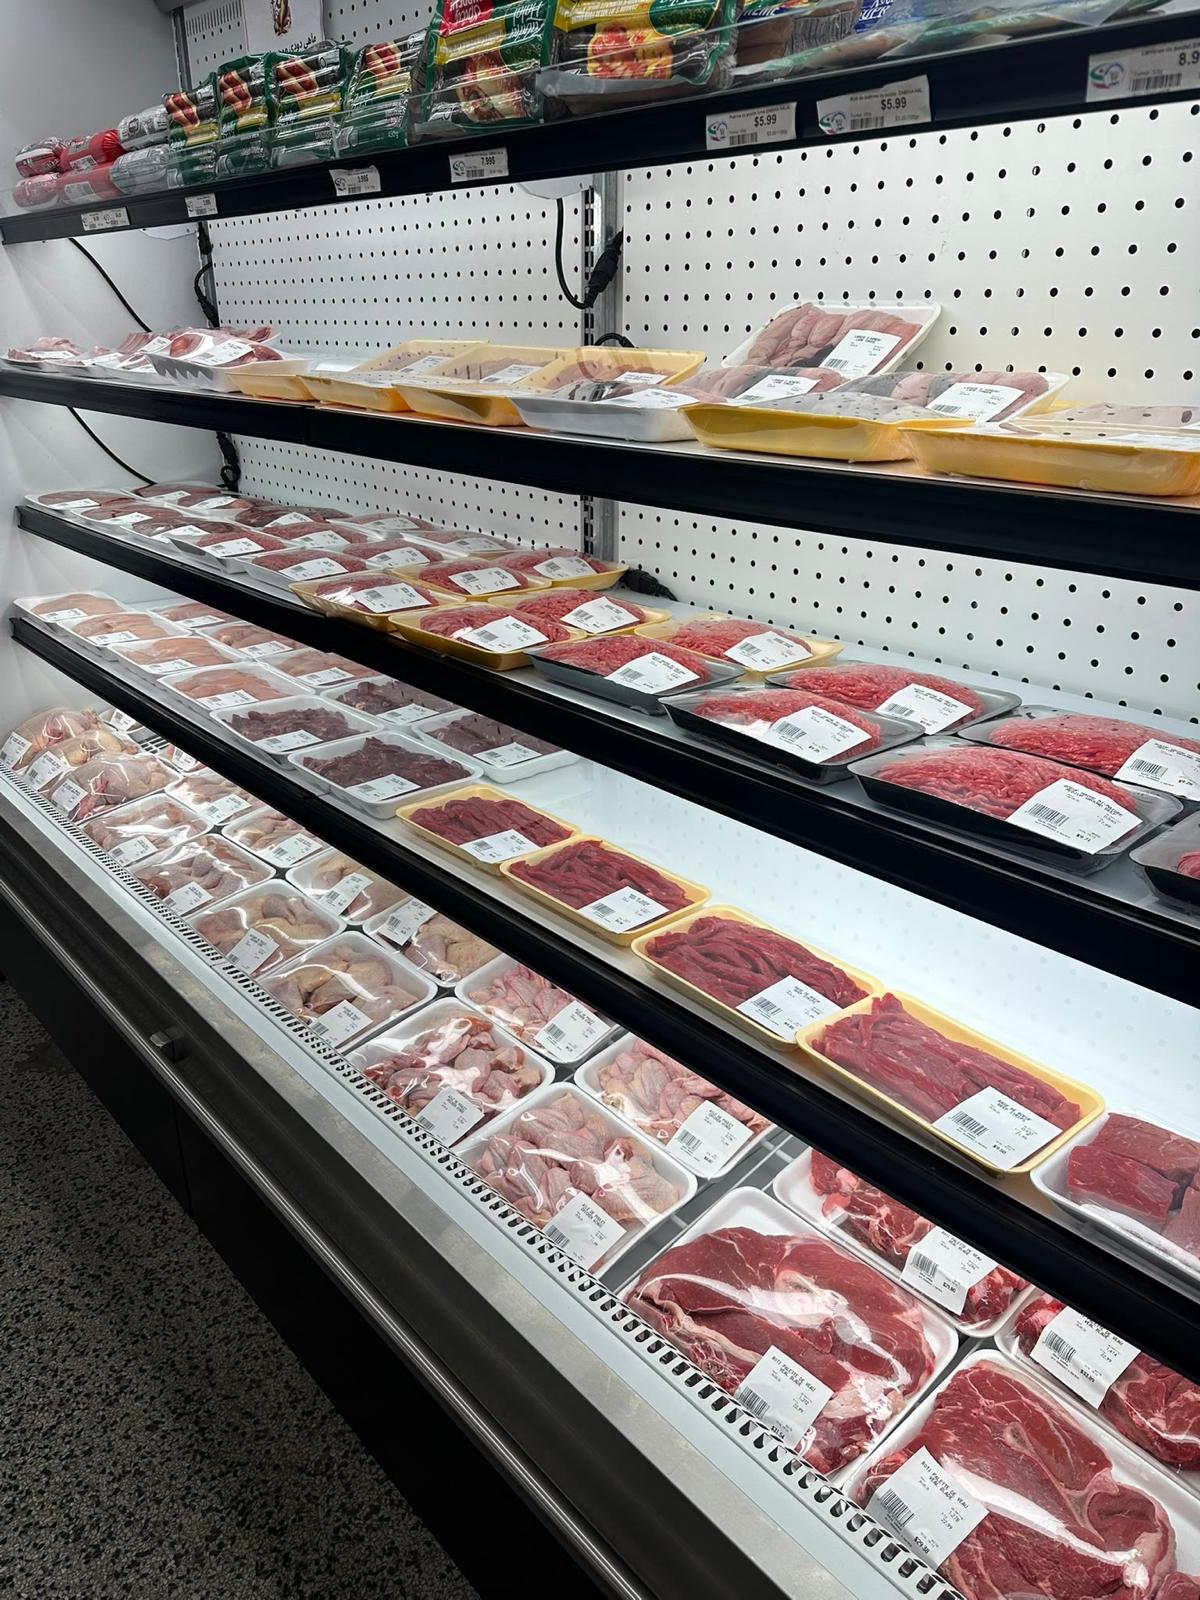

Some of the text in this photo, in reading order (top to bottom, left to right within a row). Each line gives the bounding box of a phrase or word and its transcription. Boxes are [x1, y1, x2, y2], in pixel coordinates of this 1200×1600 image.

[880, 96, 907, 110] $5.99
[753, 114, 777, 127] $5.99
[769, 1425, 786, 1439] $31.54
[912, 1535, 931, 1554] $29.38
